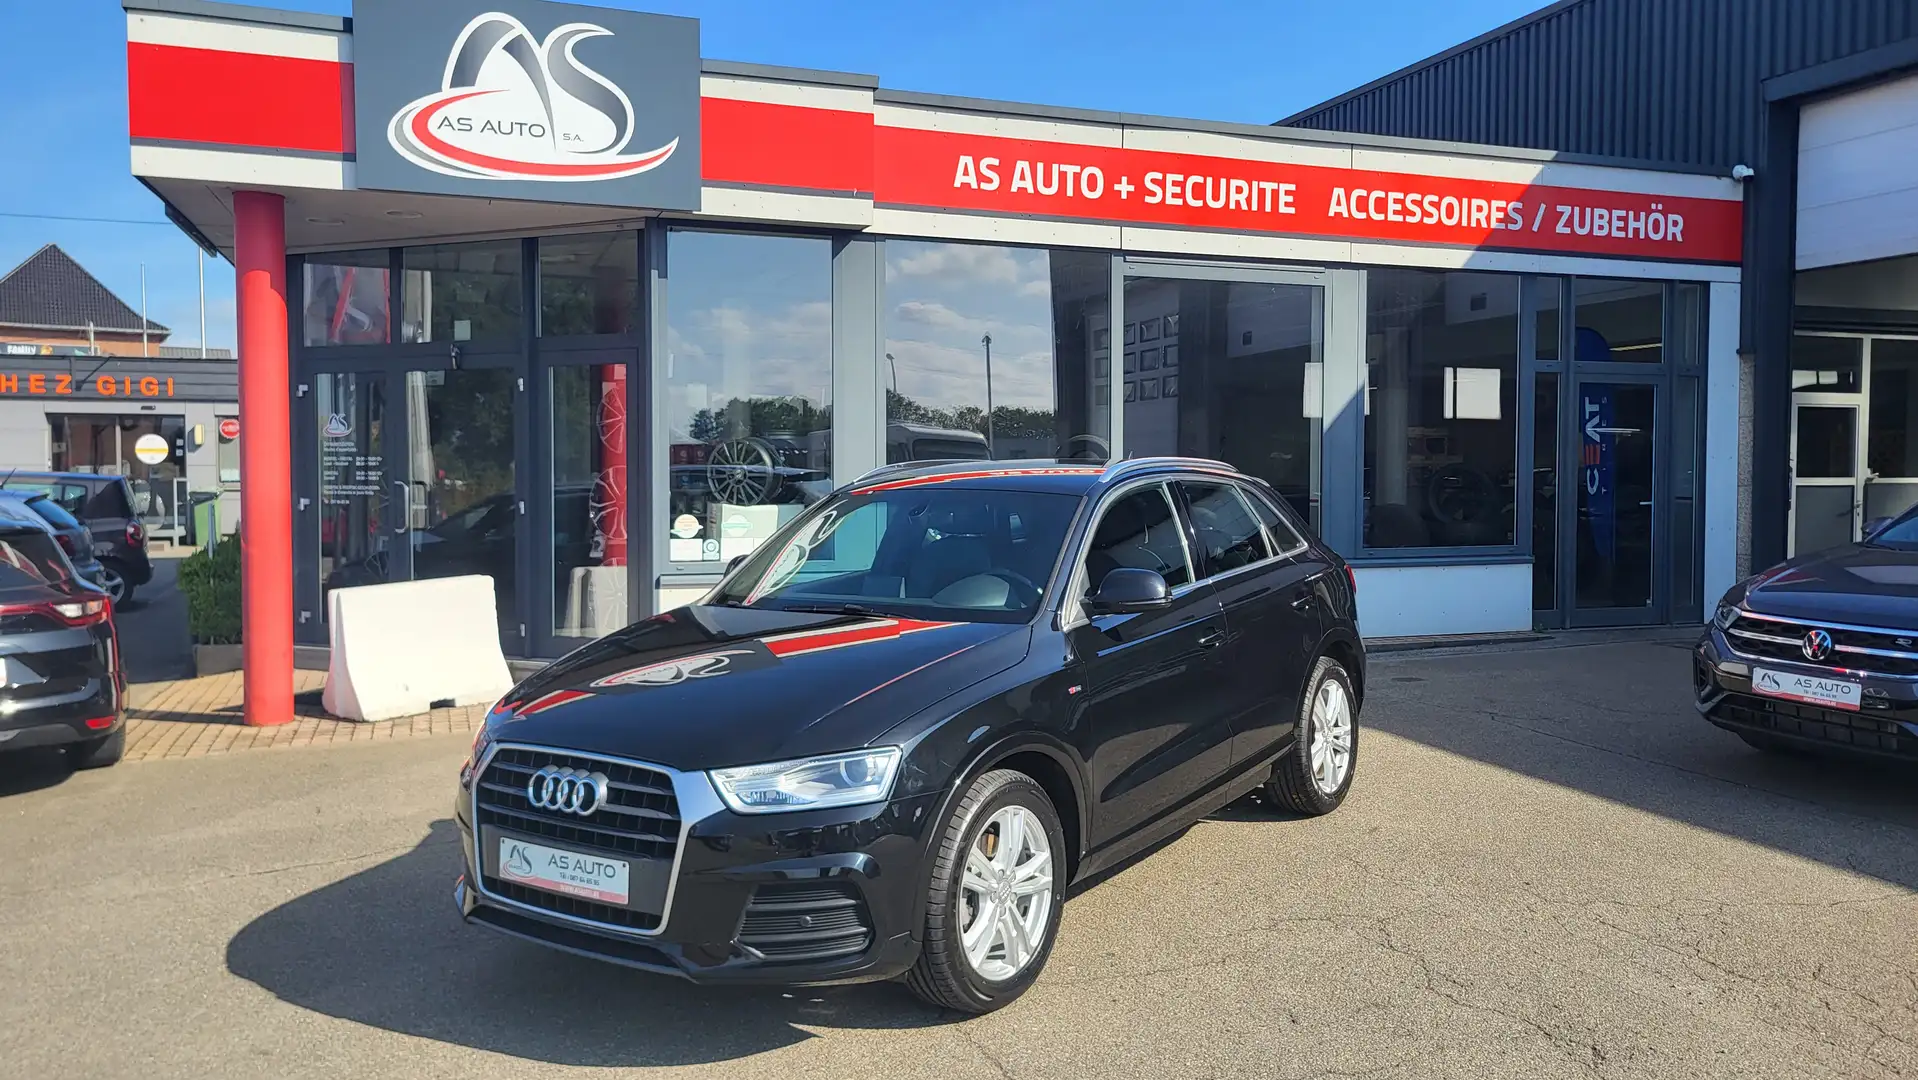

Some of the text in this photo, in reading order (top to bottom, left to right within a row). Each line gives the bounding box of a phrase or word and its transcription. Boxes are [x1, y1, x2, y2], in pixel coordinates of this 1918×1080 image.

[437, 116, 584, 141] AS AUTO S.A.
[953, 155, 1000, 191] AS
[1010, 160, 1104, 200] AUTO
[1113, 176, 1135, 200] +
[1144, 171, 1297, 215] SECURITE
[1327, 187, 1524, 231] ACCESSOIRES
[1555, 203, 1685, 242] ZUBEHÖR
[96, 375, 175, 397] GIGI
[1794, 678, 1851, 694] AS AUTO
[548, 853, 616, 878] AS AUTO
